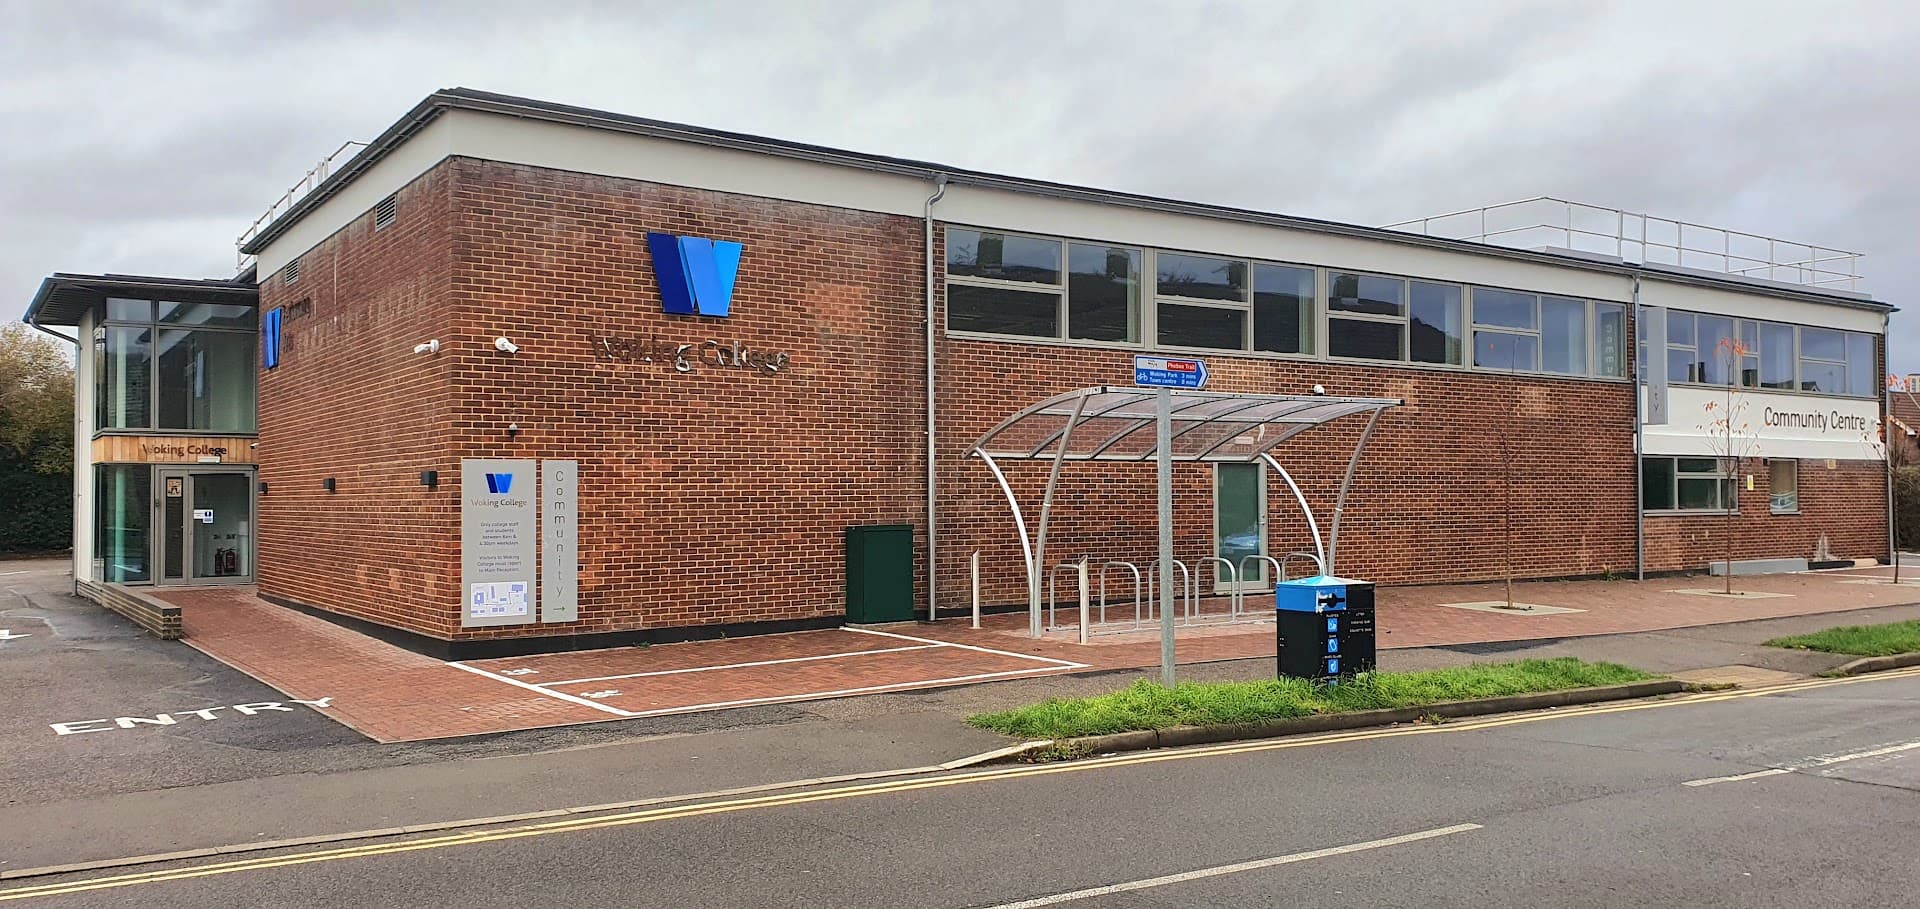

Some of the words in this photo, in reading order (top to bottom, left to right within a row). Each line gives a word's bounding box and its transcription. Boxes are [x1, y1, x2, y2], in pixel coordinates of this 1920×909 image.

[589, 333, 693, 373] Woking
[700, 339, 789, 376] College
[1764, 406, 1828, 433] Community
[1831, 410, 1866, 431] Centre
[187, 445, 227, 456] College
[471, 499, 499, 508] Woking
[500, 499, 528, 507] College
[554, 470, 566, 598] Community
[50, 697, 334, 736] ENTRY
